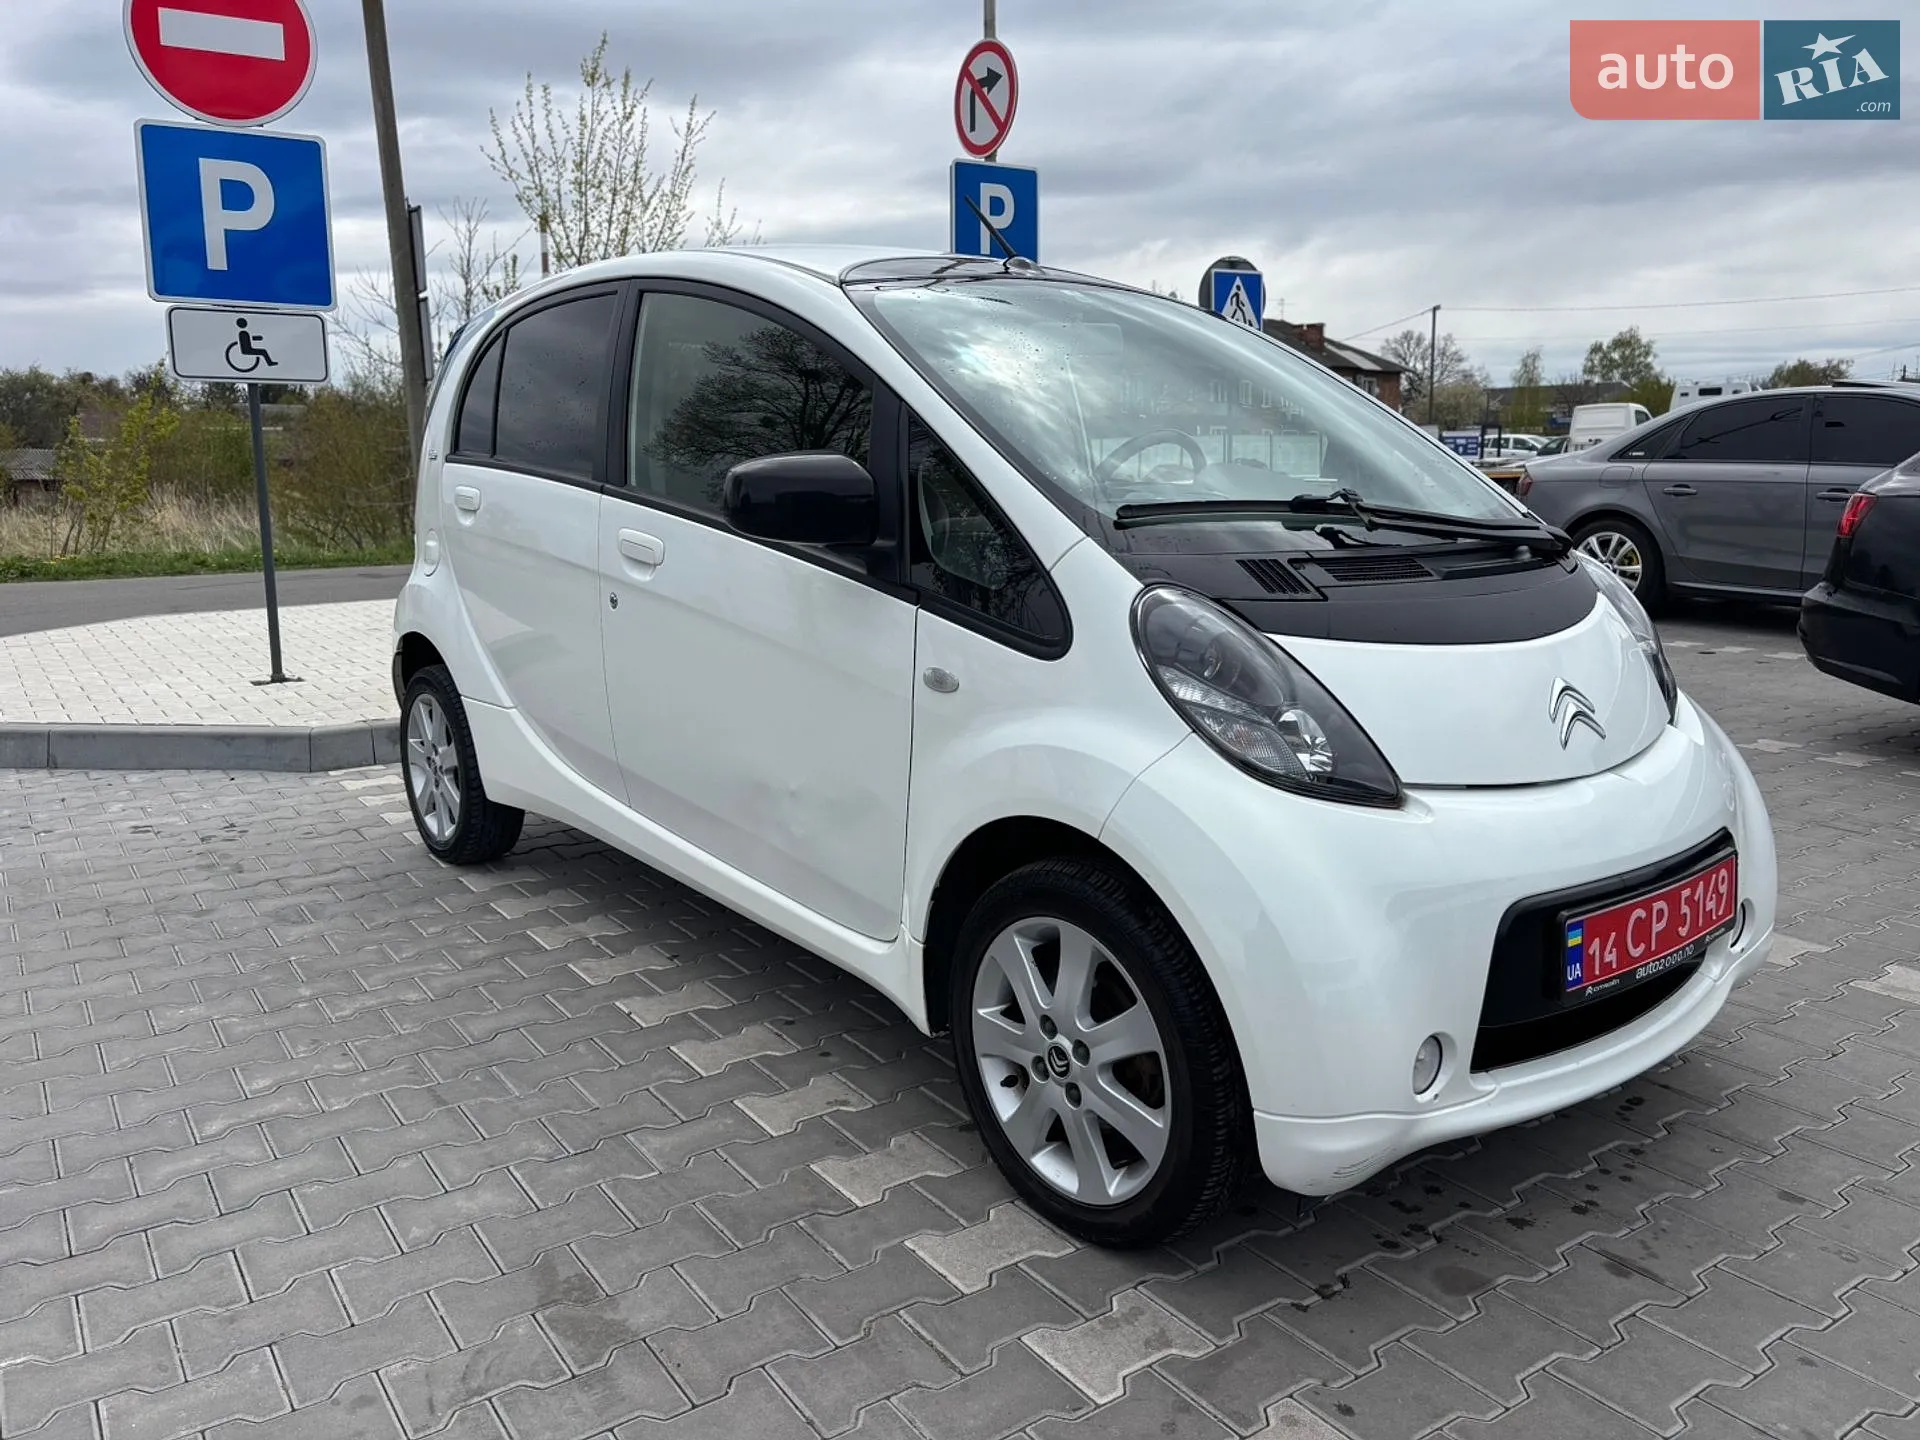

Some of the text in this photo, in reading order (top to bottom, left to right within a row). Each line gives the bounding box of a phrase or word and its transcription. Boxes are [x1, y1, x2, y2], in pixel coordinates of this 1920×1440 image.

[198, 157, 275, 270] P
[980, 182, 1015, 255] P
[1587, 868, 1729, 976] 14 CP 5149
[1566, 962, 1582, 981] UA
